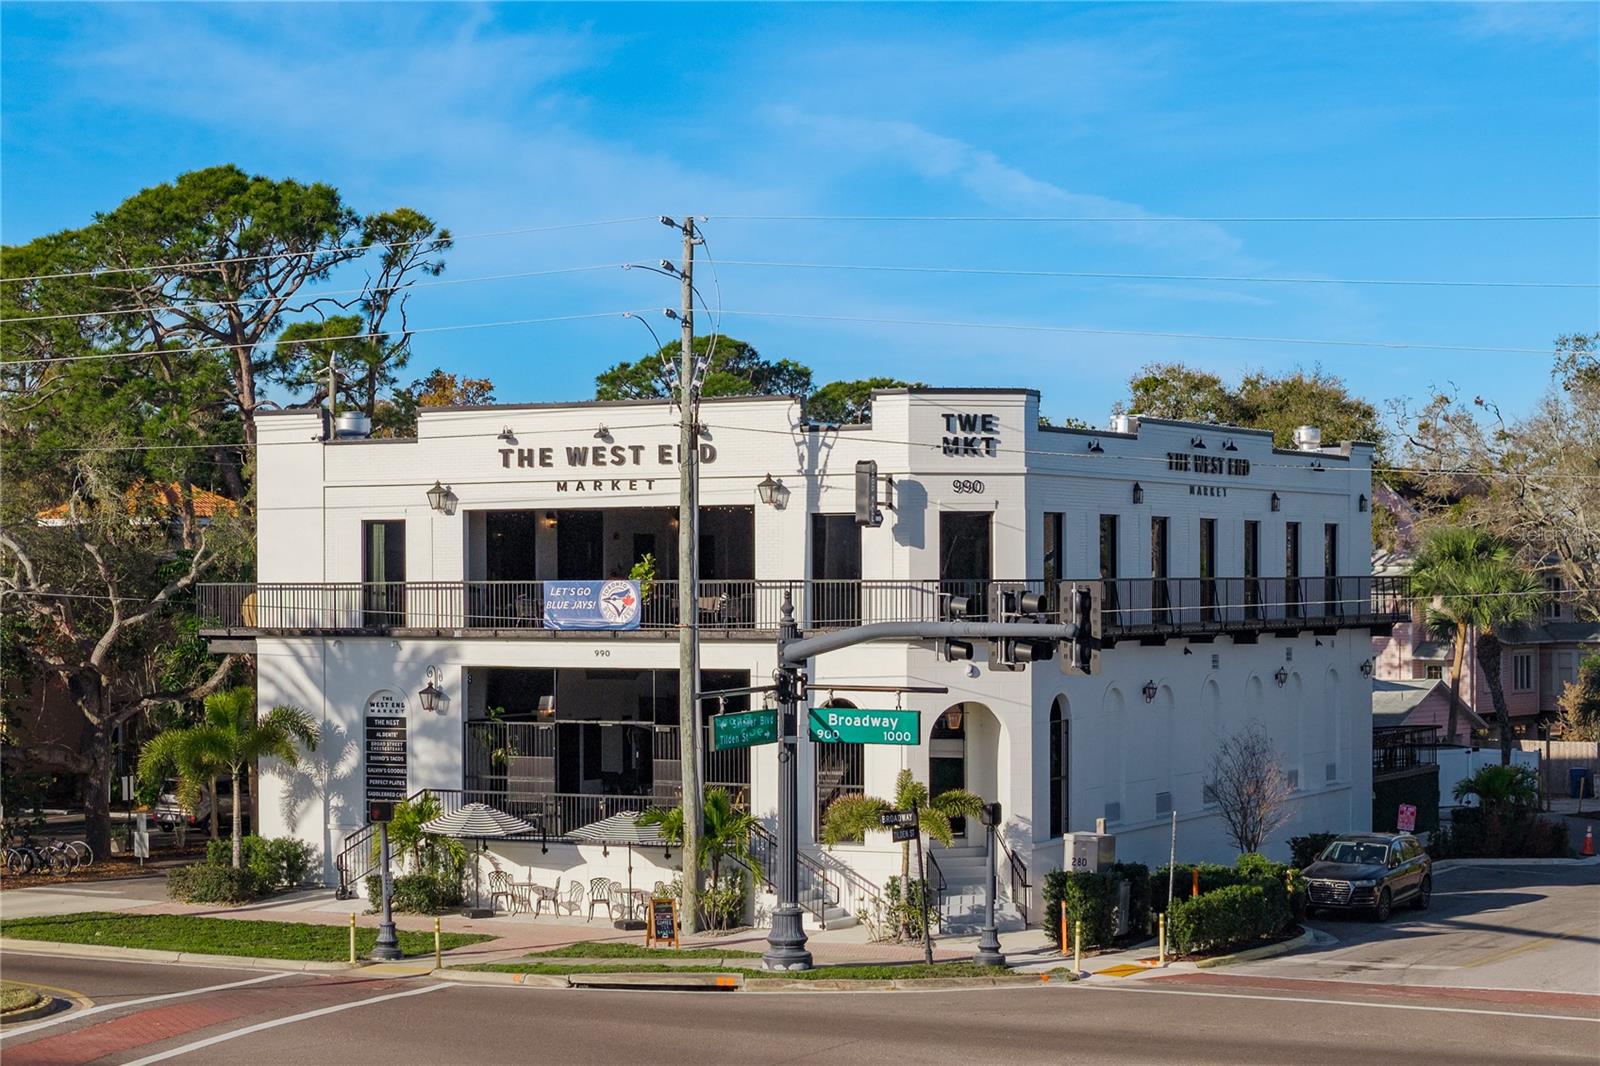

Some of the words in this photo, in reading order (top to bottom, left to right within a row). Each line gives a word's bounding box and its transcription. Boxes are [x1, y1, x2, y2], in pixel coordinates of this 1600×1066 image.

[941, 413, 997, 433] TWE
[942, 437, 997, 455] MKT
[498, 448, 554, 468] THE
[566, 444, 645, 467] WEST
[658, 443, 718, 464] ED
[1167, 452, 1191, 472] THE
[1193, 454, 1225, 475] WEST
[1228, 458, 1251, 477] END
[556, 479, 656, 492] MARKET
[953, 479, 984, 494] 990
[1189, 484, 1228, 498] MARKET
[550, 587, 576, 596] LET'S
[576, 587, 592, 596] GO
[546, 600, 570, 610] BLUE
[571, 600, 597, 610] JAYS!
[594, 649, 611, 658] 990
[828, 713, 899, 731] Broadway
[719, 734, 740, 745] Tilden
[816, 729, 840, 739] 900
[883, 731, 911, 742] 1000
[881, 813, 913, 824] BROADWAY
[1071, 857, 1088, 867] 280
